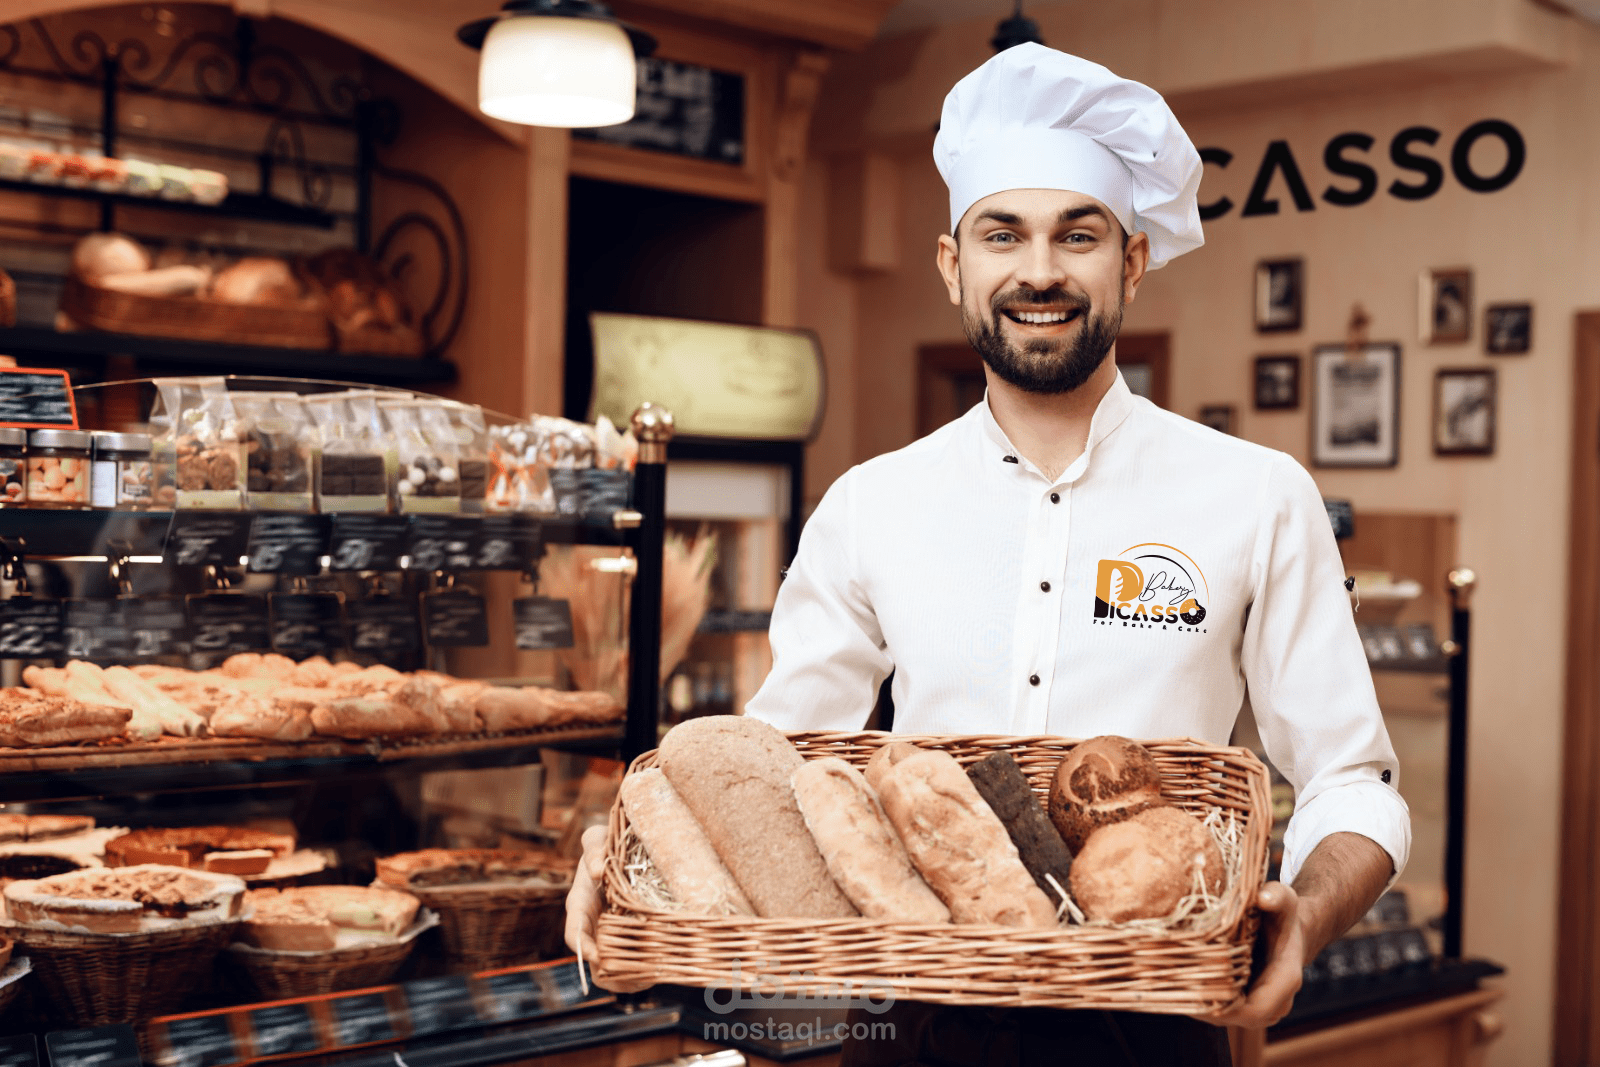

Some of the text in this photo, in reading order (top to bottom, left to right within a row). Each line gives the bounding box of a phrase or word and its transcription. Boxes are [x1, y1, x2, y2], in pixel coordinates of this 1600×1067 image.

[1093, 559, 1207, 626] PICASSO
[1138, 570, 1194, 606] Bakery
[1092, 618, 1113, 626] For
[1122, 620, 1153, 629] Bake
